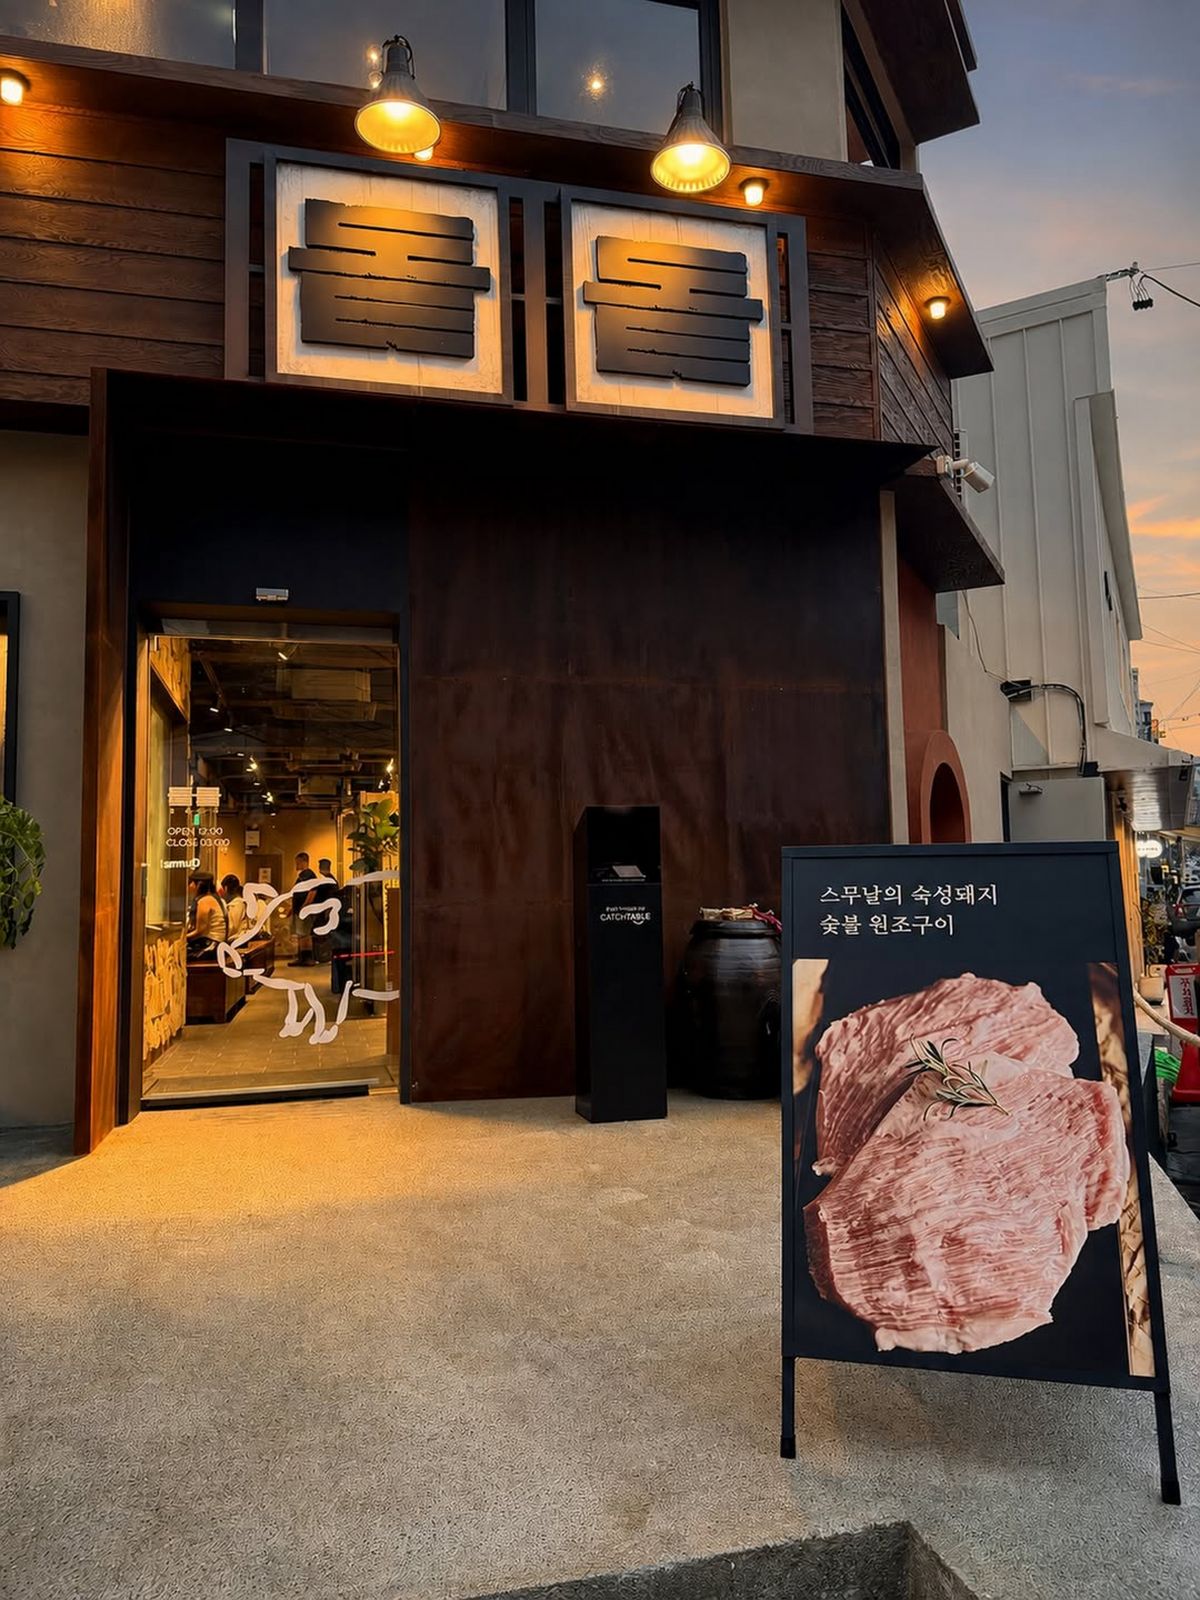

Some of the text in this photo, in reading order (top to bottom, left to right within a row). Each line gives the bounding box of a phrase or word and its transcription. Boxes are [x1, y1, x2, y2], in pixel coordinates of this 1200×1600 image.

[819, 883, 999, 906] 스무날의 숙성돼지
[600, 912, 652, 923] CATCHTABLE
[819, 913, 955, 936] 숯불 원조구이
